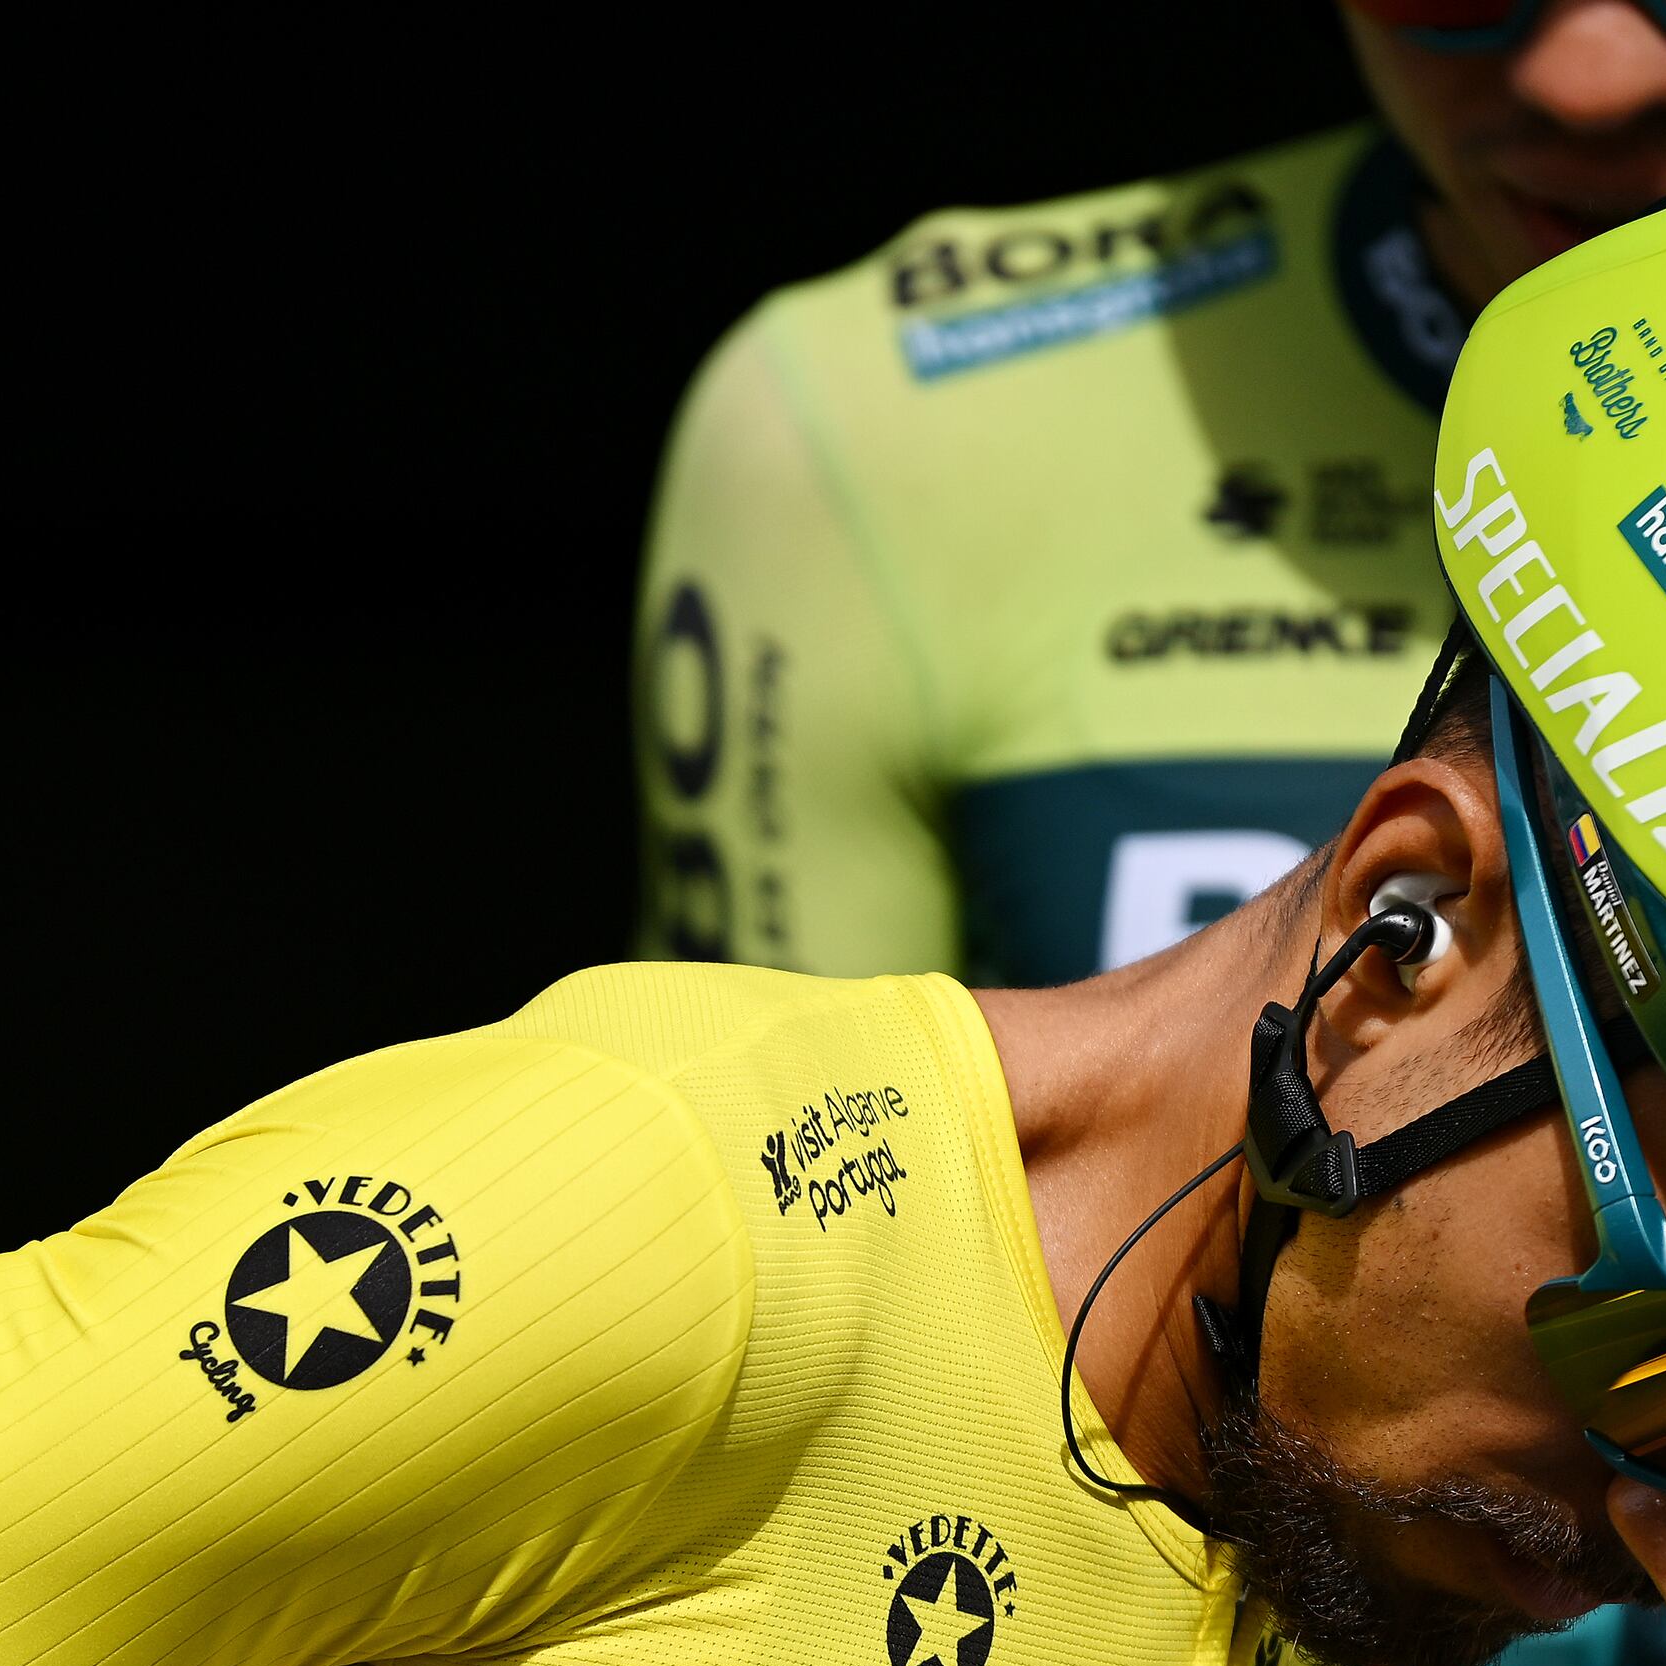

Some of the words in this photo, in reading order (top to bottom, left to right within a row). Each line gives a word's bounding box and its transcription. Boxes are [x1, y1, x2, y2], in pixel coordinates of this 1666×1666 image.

[1570, 327, 1649, 440] Brothers
[1633, 318, 1664, 358] BAND
[1597, 860, 1623, 907] Daniel
[1583, 864, 1648, 995] MARTINEZ
[791, 1104, 834, 1172] visit
[824, 1086, 909, 1137] Algarve
[1579, 1114, 1617, 1185] KOO
[809, 1138, 907, 1233] portugal
[303, 1175, 461, 1346] VEDETTE
[179, 1320, 256, 1424] Cycling
[887, 1514, 1018, 1602] VEDETTE
